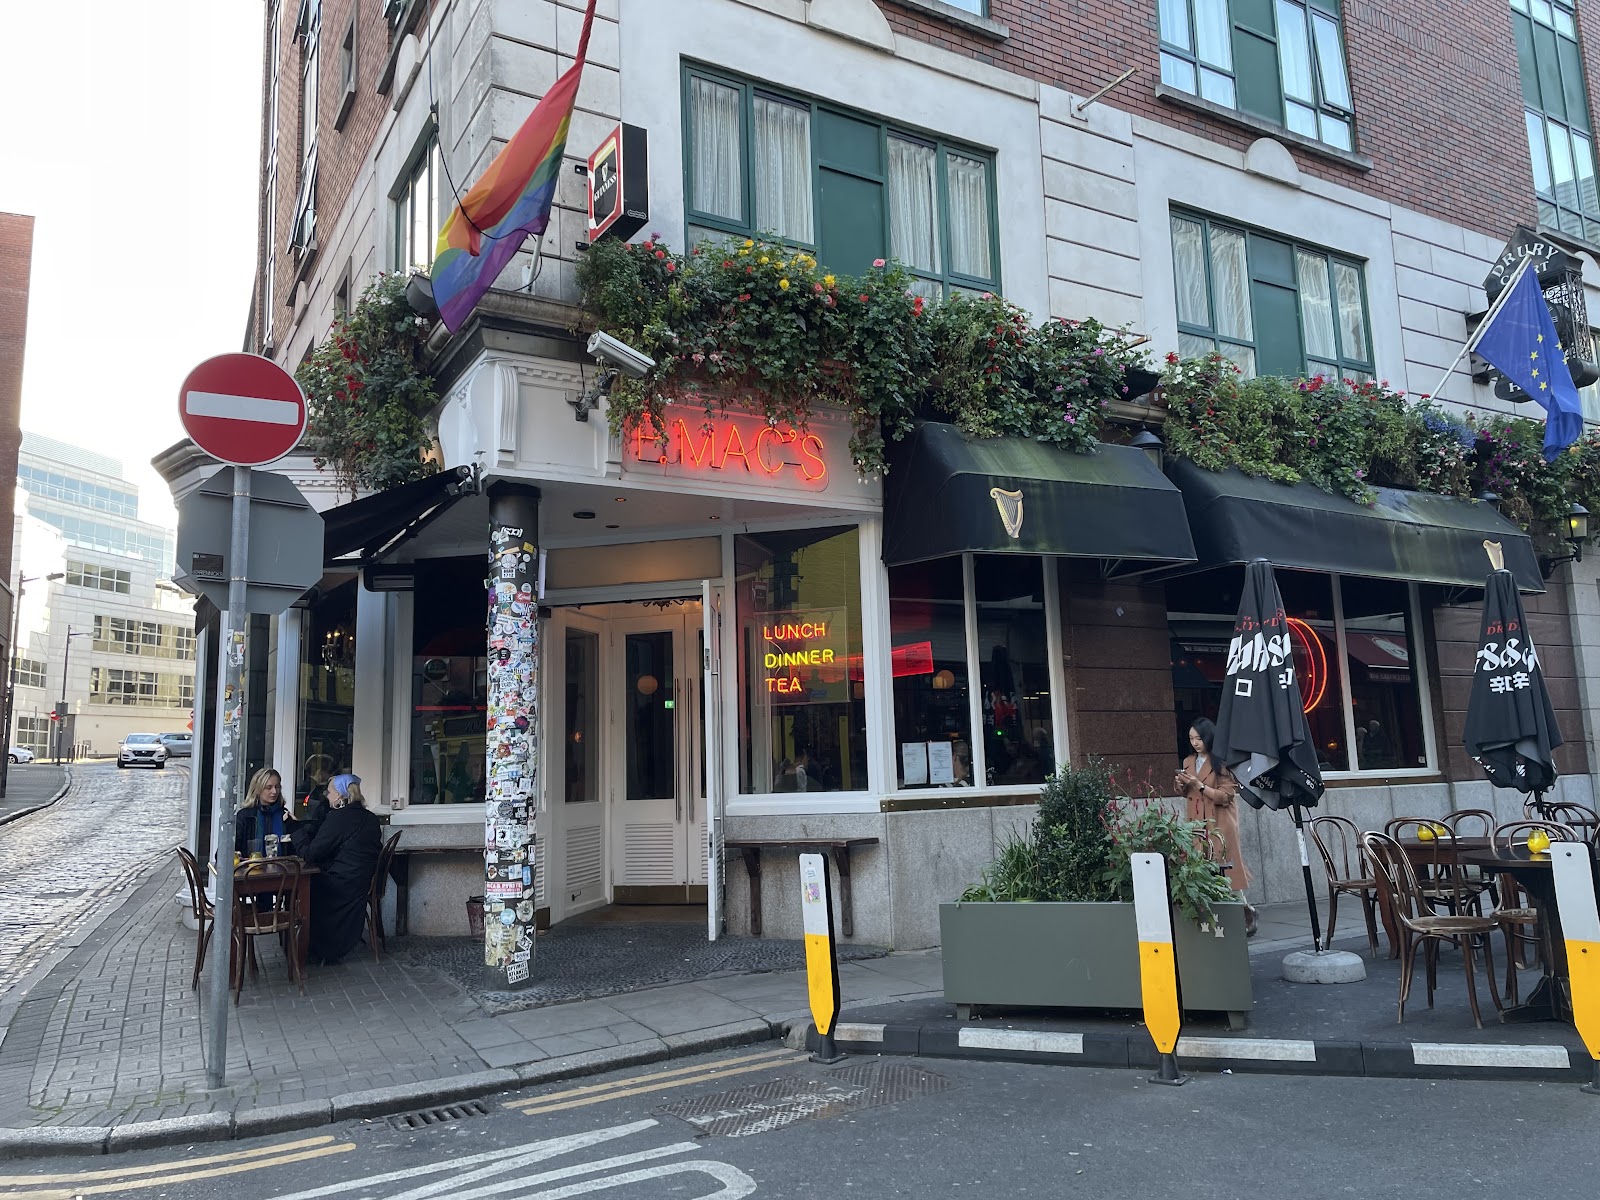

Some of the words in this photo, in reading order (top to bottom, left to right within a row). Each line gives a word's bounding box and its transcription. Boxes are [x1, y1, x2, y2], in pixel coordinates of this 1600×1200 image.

[1491, 242, 1559, 278] DRURY
[763, 622, 826, 641] LUNCH
[764, 649, 835, 669] DINNER
[765, 677, 803, 693] TEA
